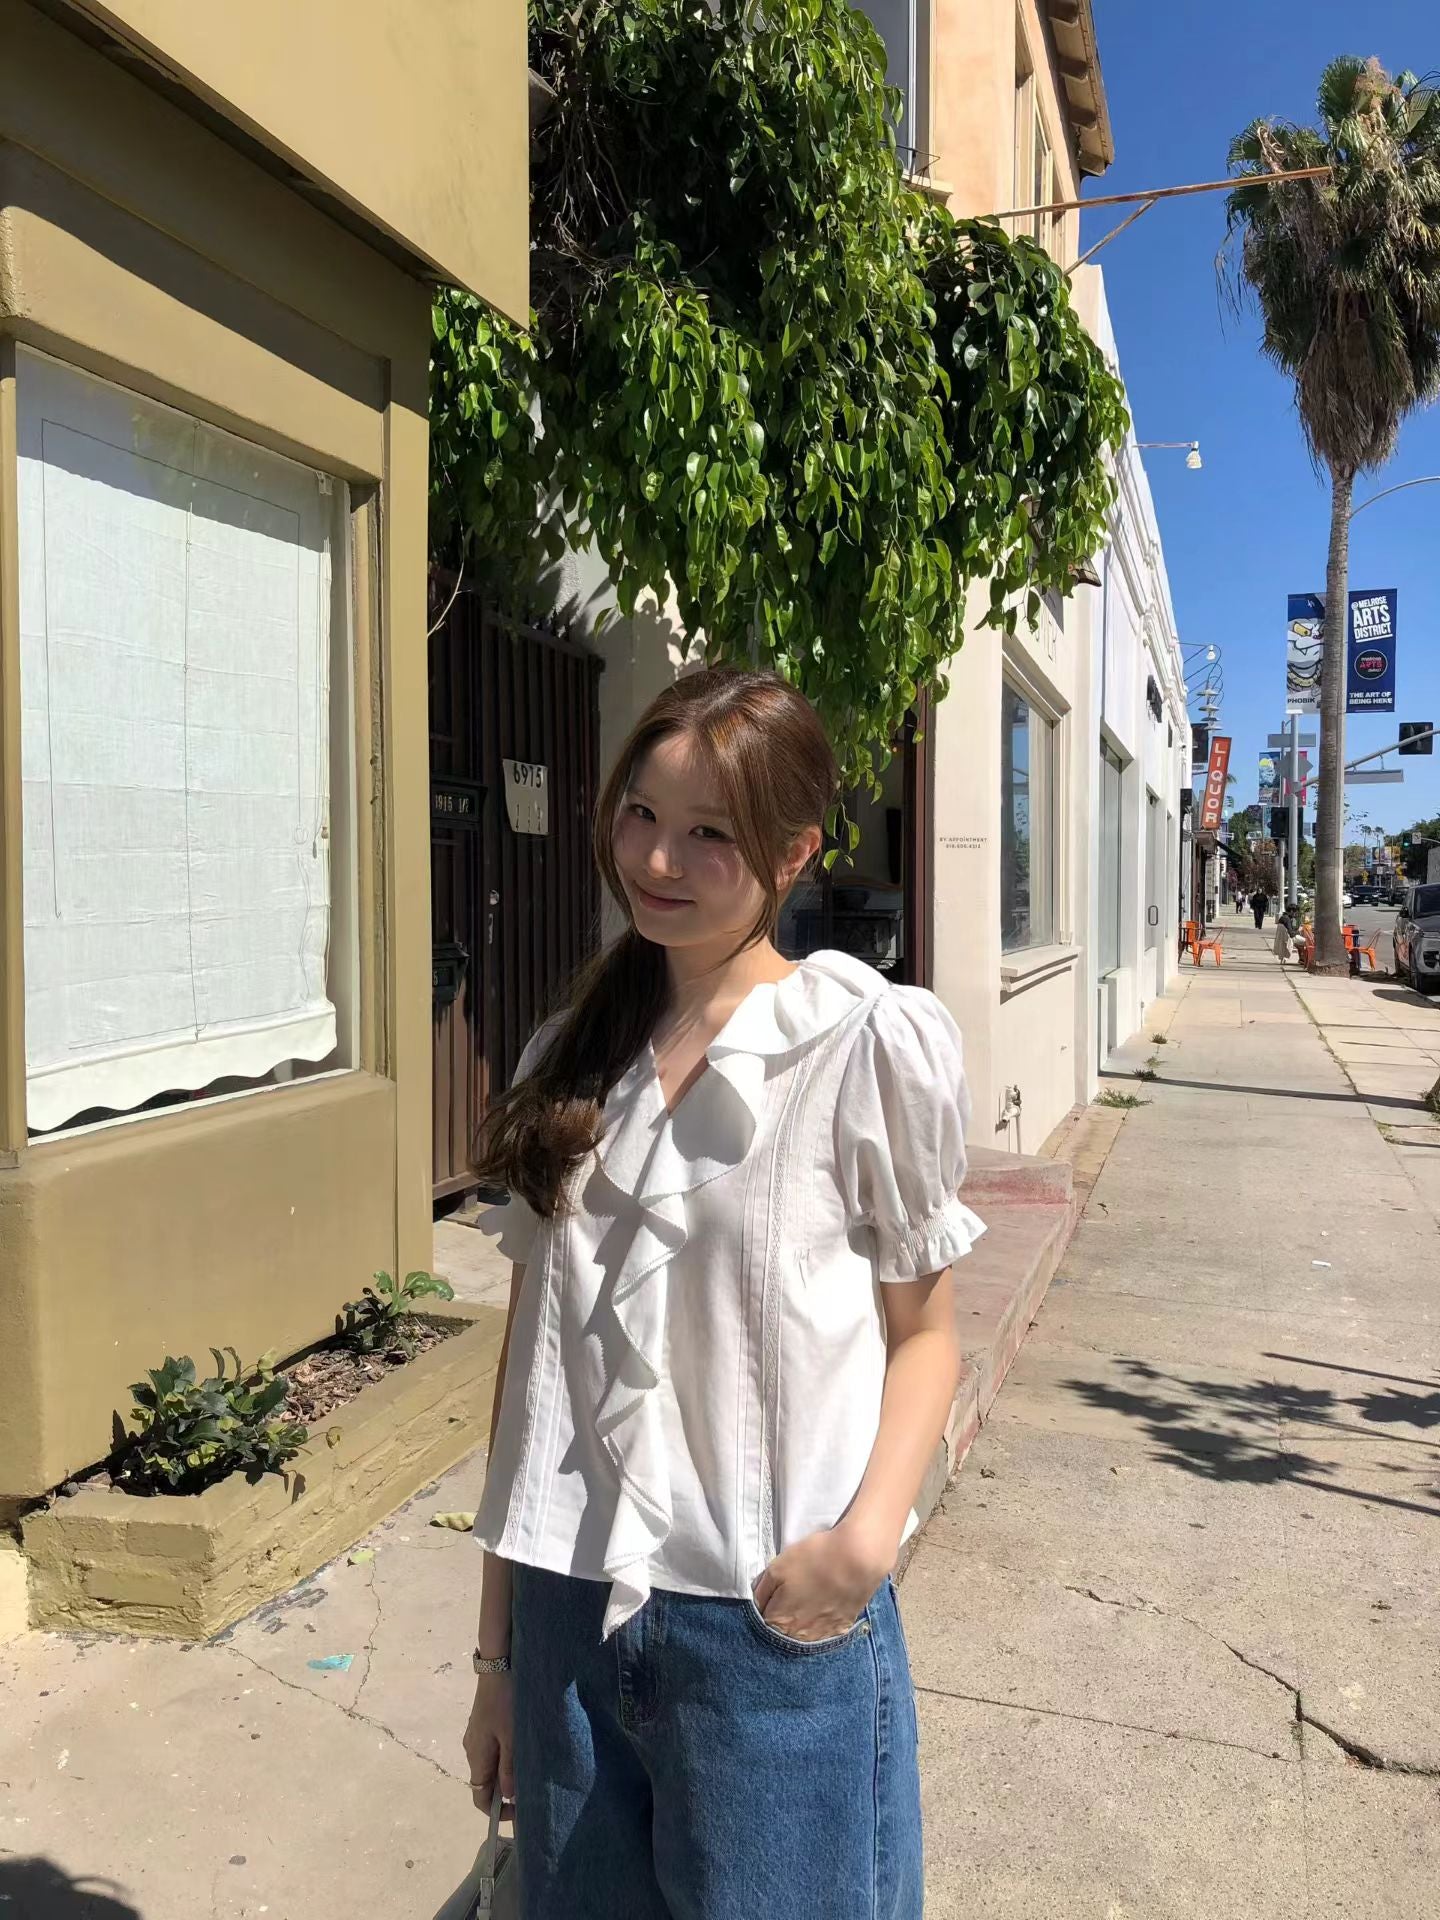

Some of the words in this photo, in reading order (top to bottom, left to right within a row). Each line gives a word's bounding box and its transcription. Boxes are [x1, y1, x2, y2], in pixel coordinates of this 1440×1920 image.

[1351, 596, 1387, 610] @MELROSE
[1353, 605, 1390, 627] ARTS
[1354, 622, 1391, 639] DISTRICT
[513, 762, 542, 788] 6915
[1205, 743, 1226, 823] LIQUOR
